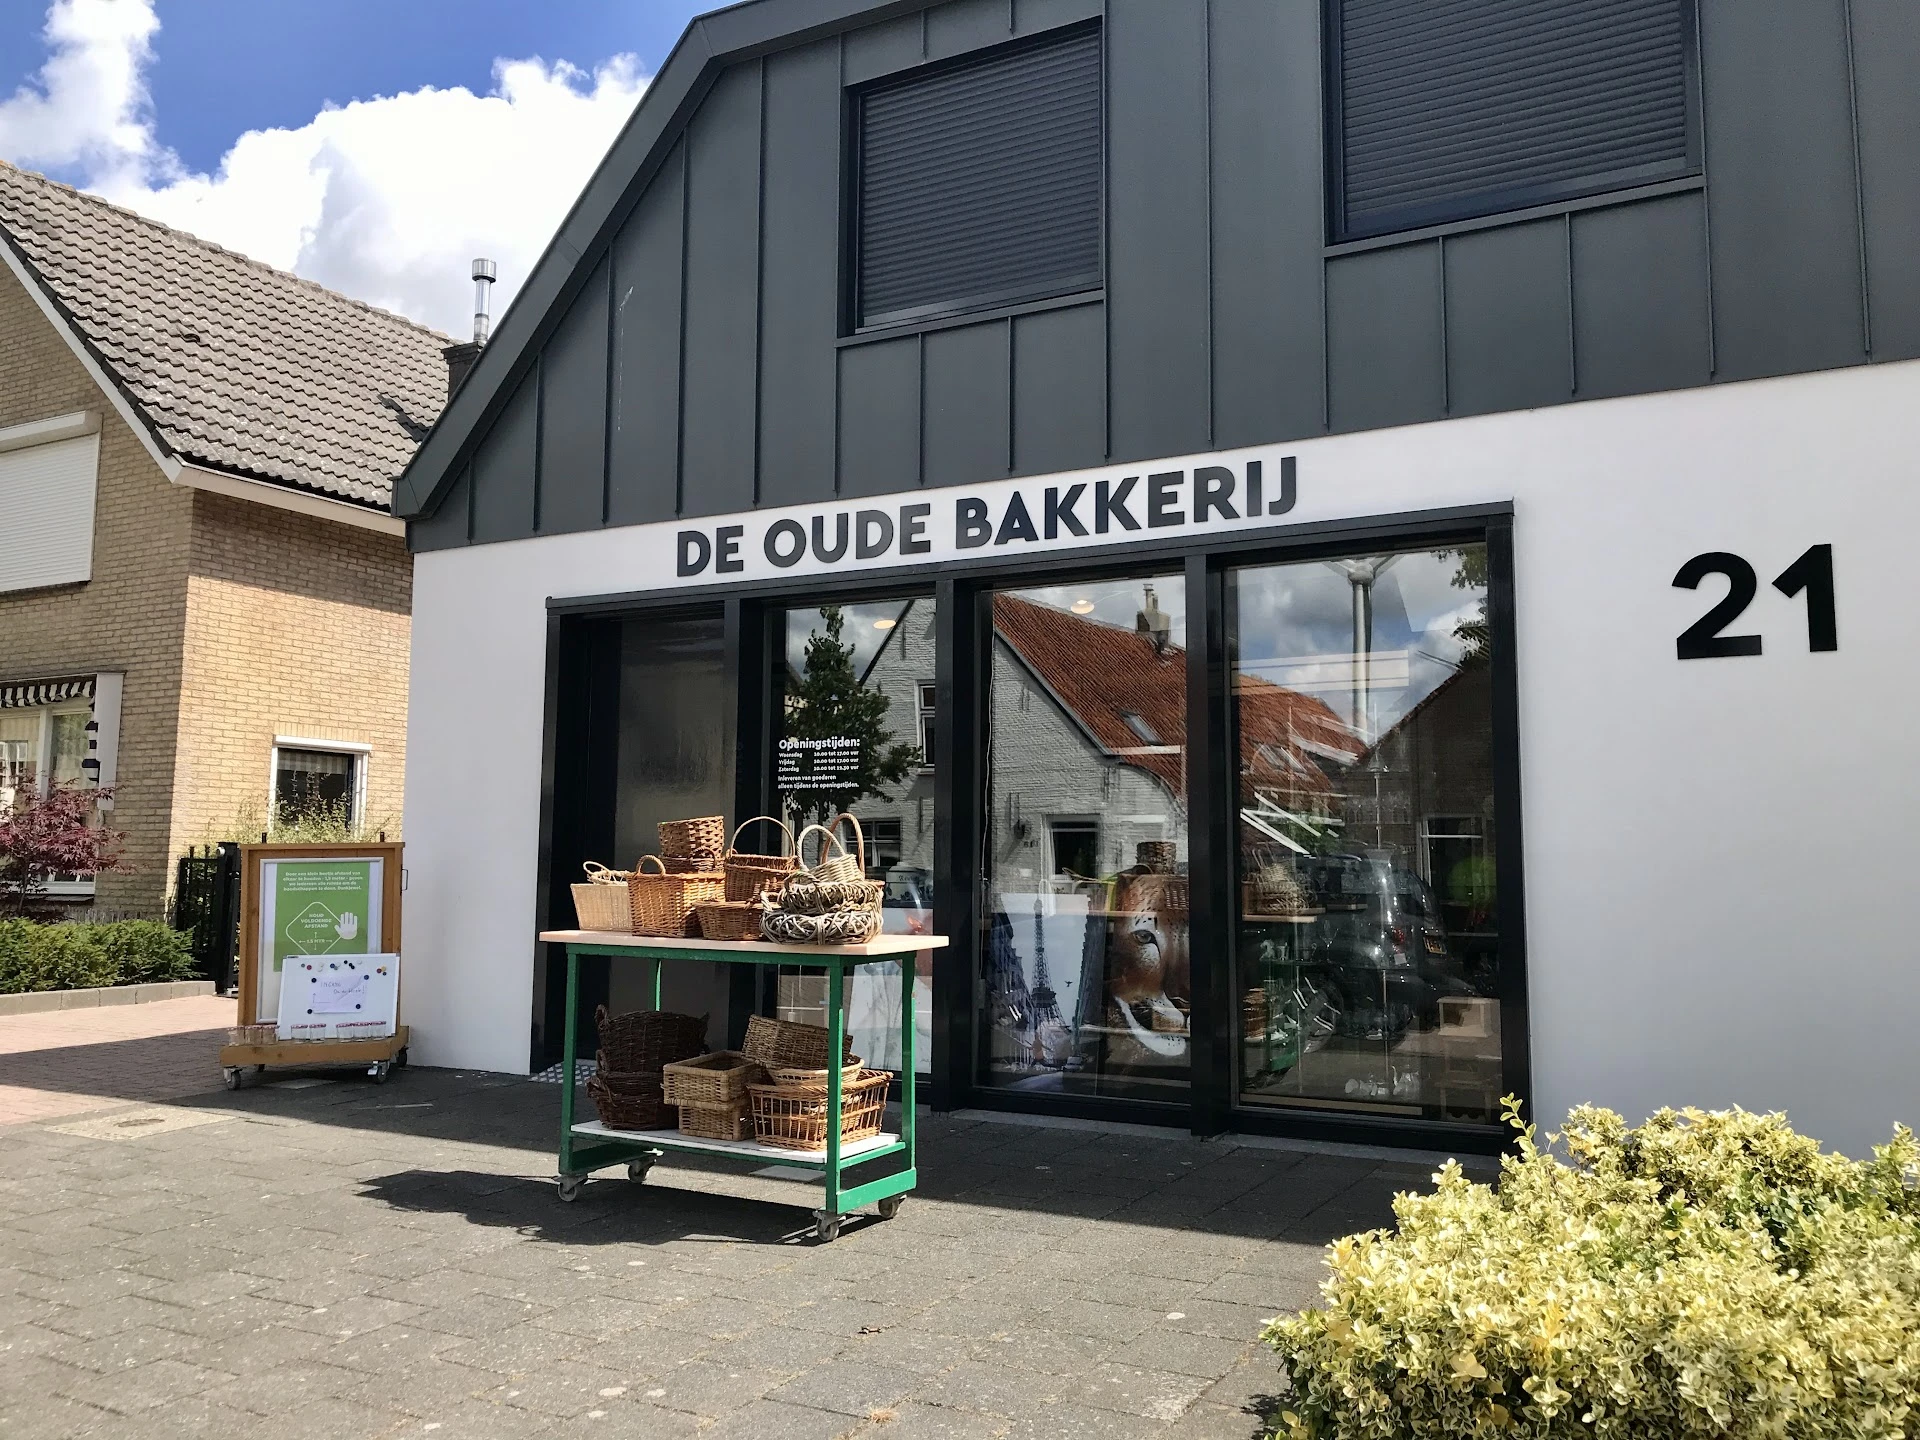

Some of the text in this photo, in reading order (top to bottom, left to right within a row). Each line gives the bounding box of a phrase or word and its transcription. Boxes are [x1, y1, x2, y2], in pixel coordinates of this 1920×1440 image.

[676, 455, 1297, 578] DE OUDE BAKKERIJ
[1671, 543, 1838, 661] 21
[779, 736, 860, 751] Openingstijden:
